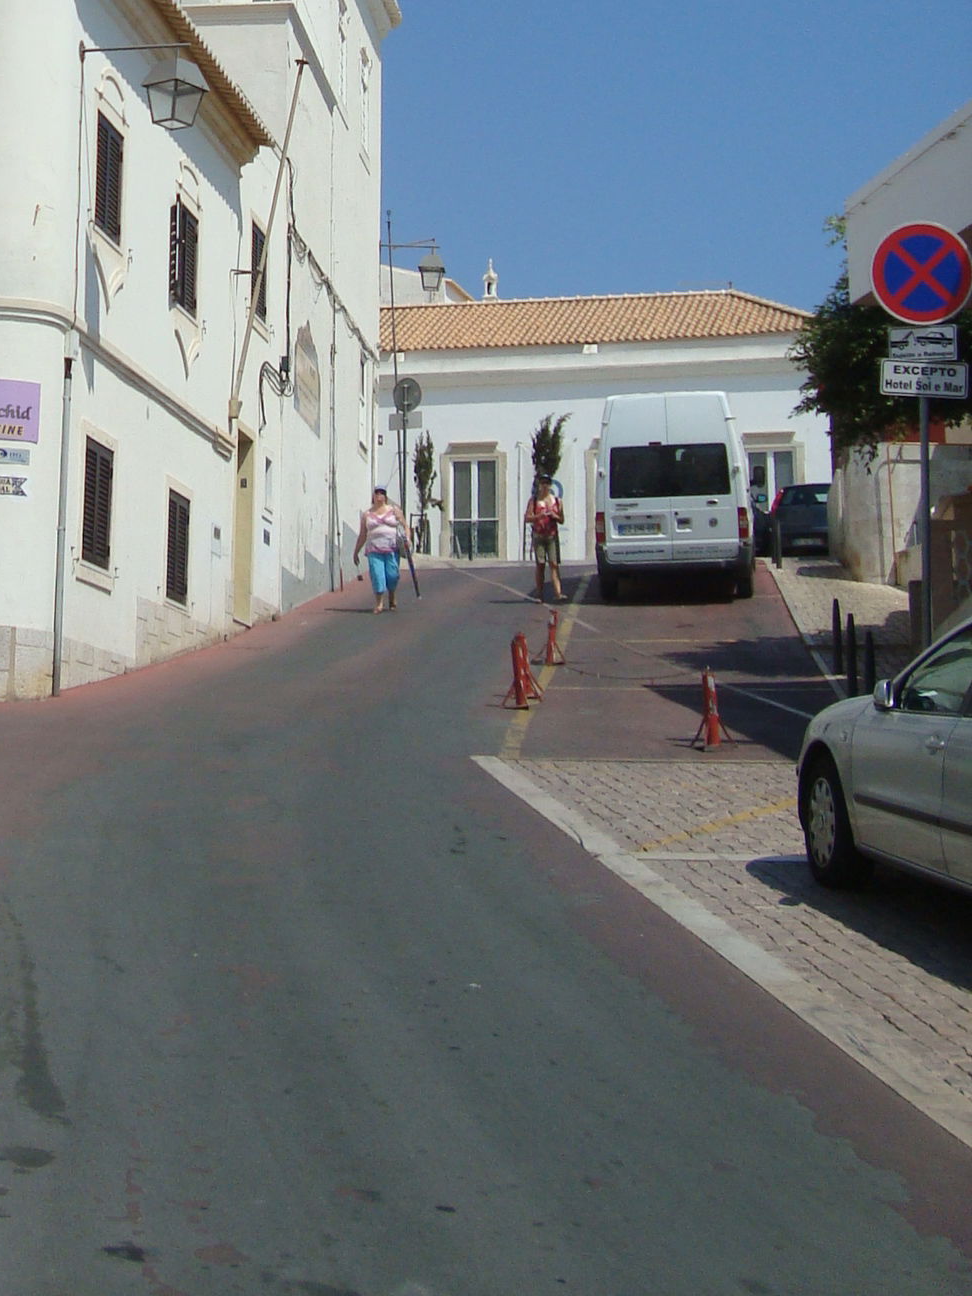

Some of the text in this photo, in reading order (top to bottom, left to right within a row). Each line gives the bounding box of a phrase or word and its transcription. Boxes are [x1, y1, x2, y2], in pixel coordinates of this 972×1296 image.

[893, 365, 956, 377] EXCEPTO
[885, 379, 963, 392] Hotel Sol e Mar
